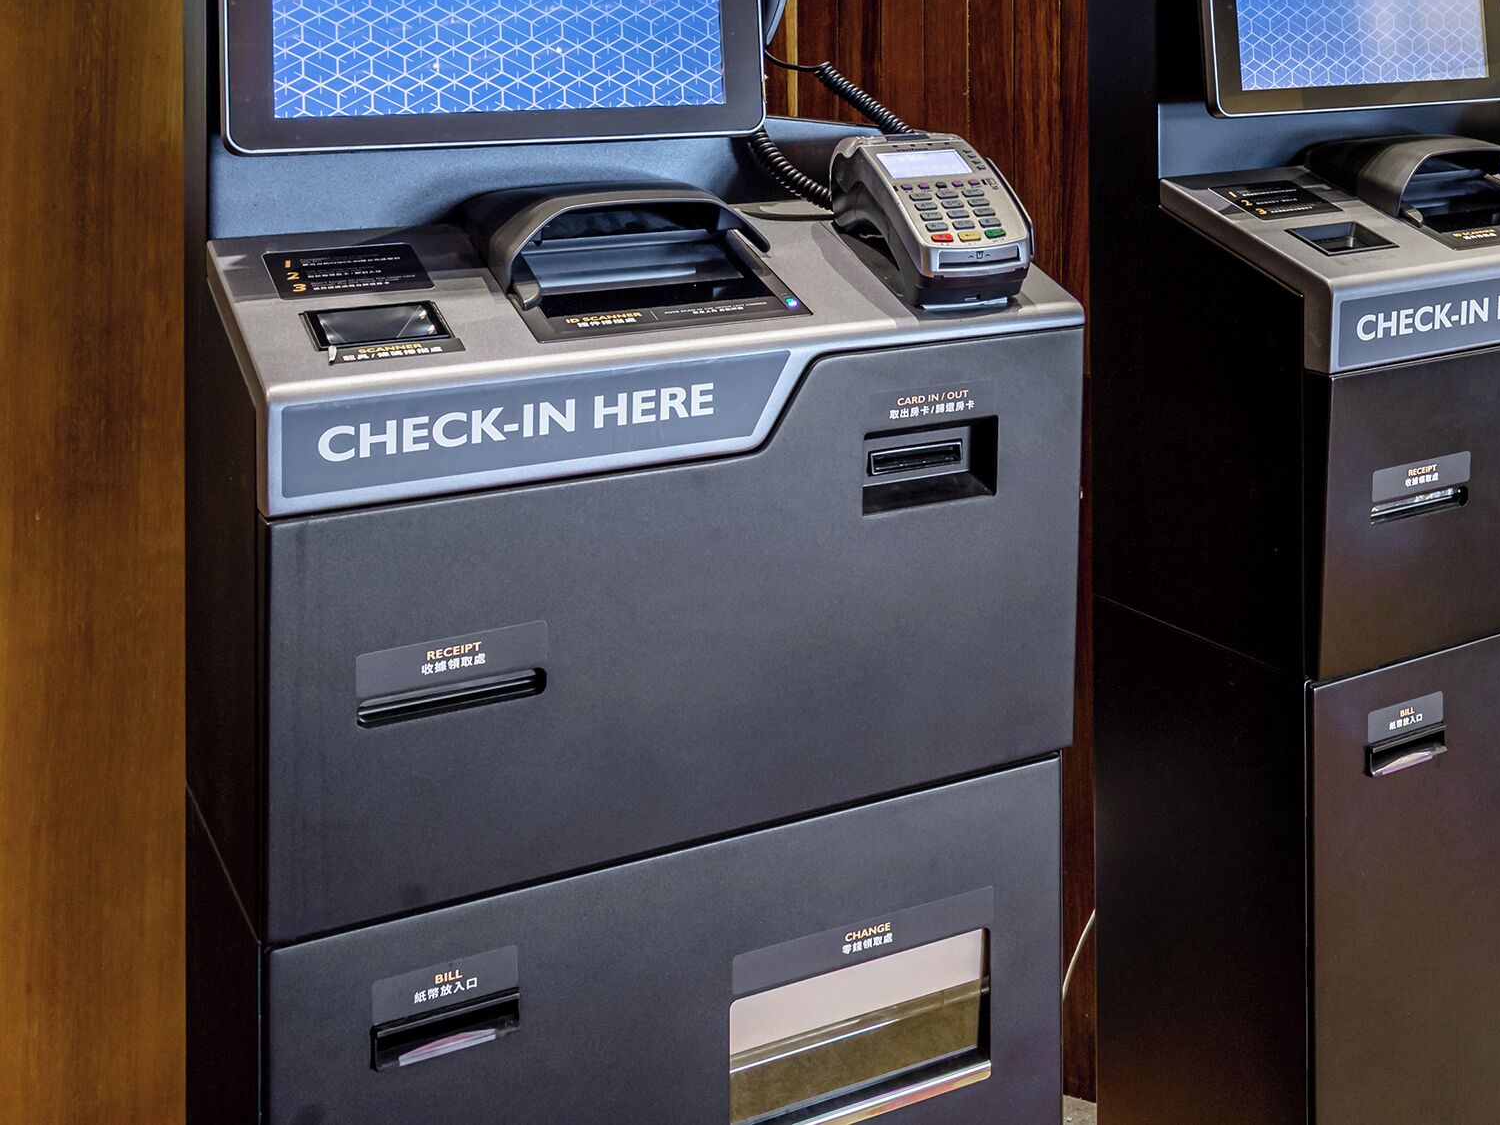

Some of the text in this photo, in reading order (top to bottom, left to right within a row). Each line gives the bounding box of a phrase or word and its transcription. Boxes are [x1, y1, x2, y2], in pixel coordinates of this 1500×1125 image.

[286, 272, 300, 280] 2
[292, 283, 307, 292] 3
[582, 312, 642, 322] SCANNER
[1356, 297, 1489, 342] CHECK-IN
[358, 343, 423, 354] SCANNER
[897, 395, 925, 406] CARD
[928, 394, 939, 402] IN
[947, 389, 969, 400] OUT
[317, 382, 715, 463] CHECK-IN HERE
[1408, 464, 1437, 477] RECEIPT
[426, 641, 482, 661] RECEIPT
[421, 653, 486, 676] 收據領取處
[1399, 707, 1415, 717] BILL
[845, 922, 891, 942] CHANGE
[434, 969, 463, 984] BILL
[413, 977, 478, 1004] 紙幣放入口
